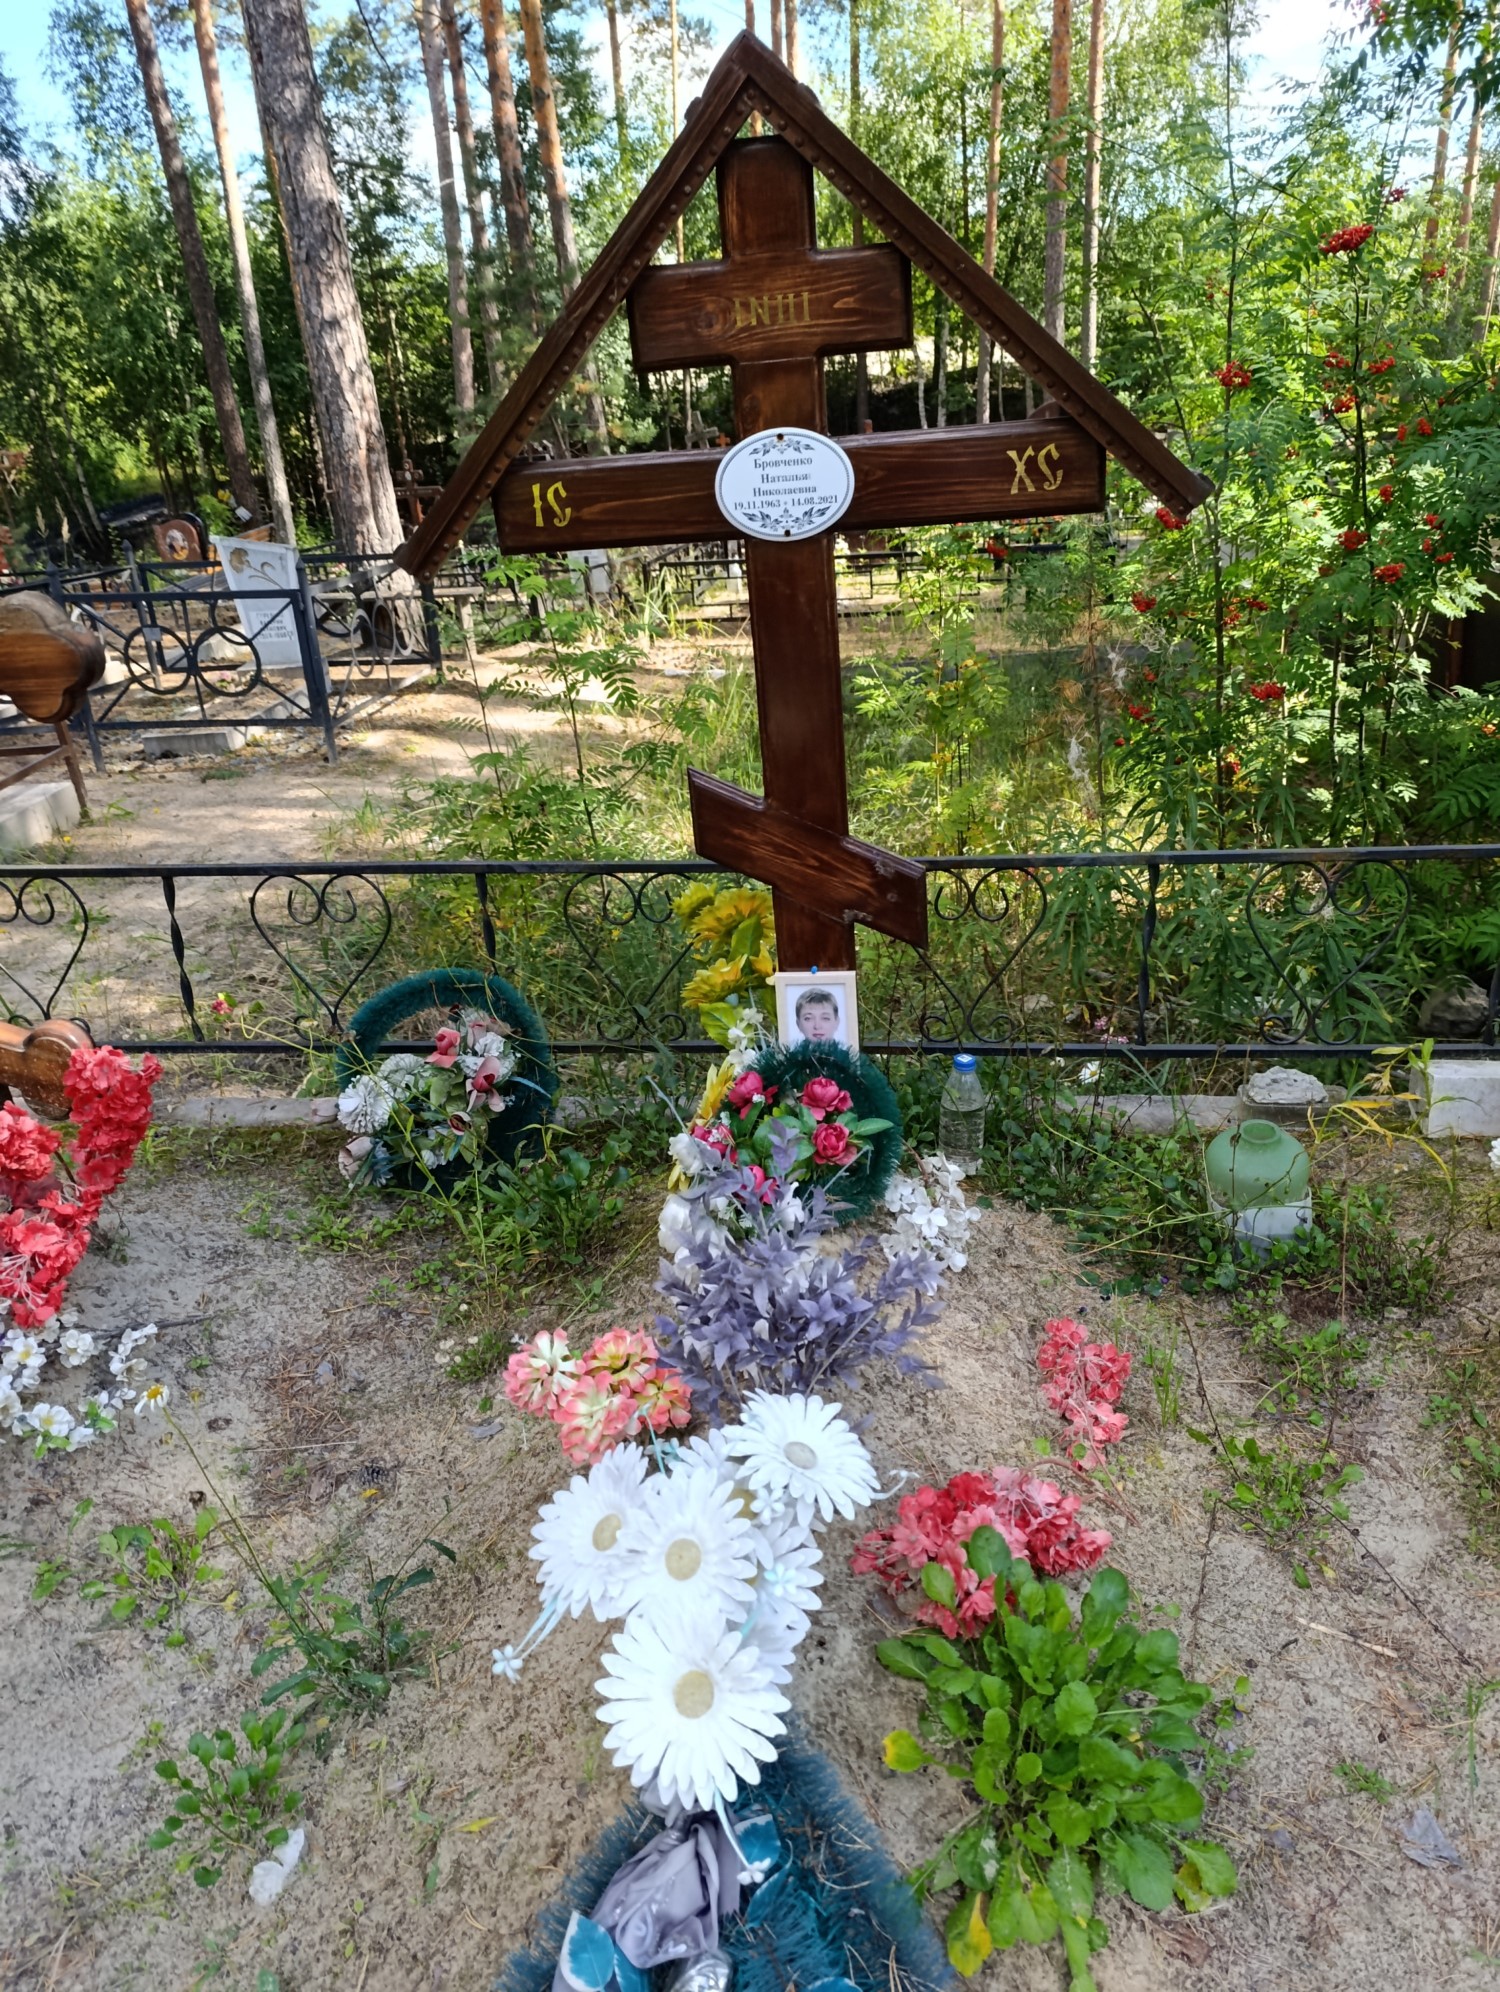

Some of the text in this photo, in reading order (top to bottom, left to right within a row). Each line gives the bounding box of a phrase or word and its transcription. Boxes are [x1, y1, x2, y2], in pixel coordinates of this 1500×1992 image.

[753, 457, 813, 471] Бровченко
[761, 473, 808, 484] Наталья
[753, 486, 817, 497] Николаевна
[733, 495, 838, 511] 19.11.1963 14.08.2021
